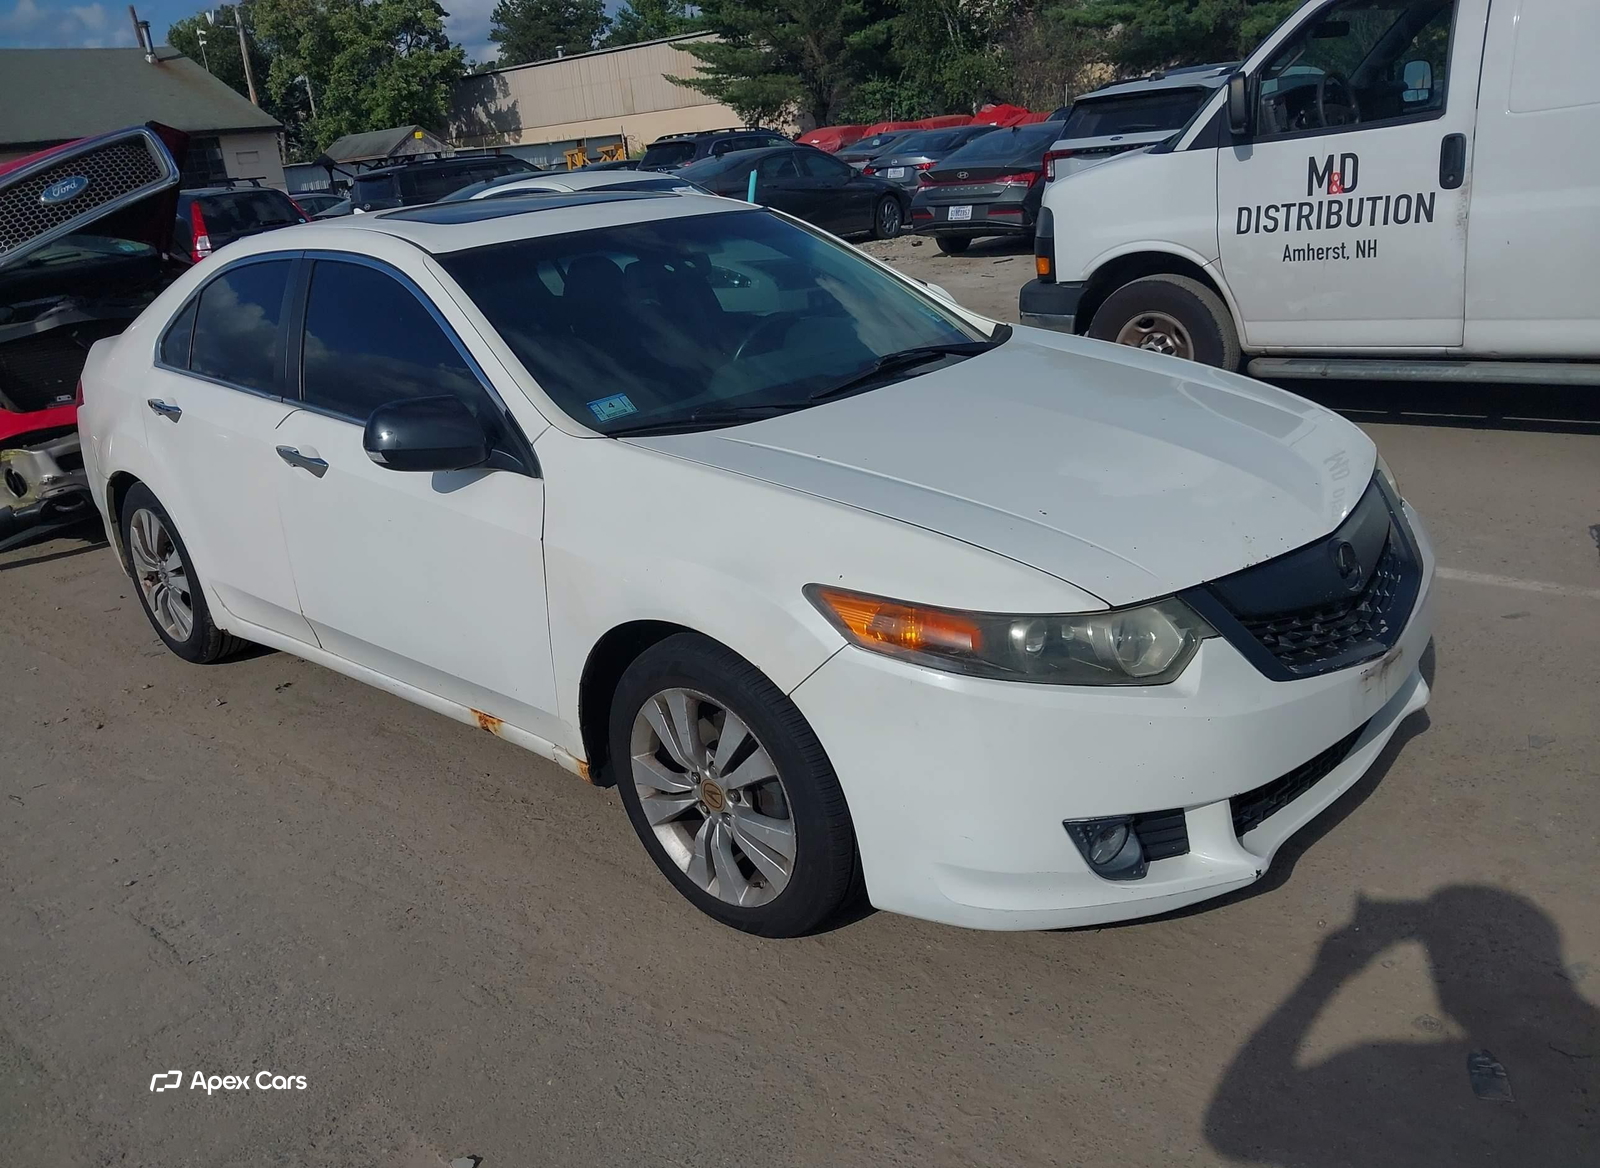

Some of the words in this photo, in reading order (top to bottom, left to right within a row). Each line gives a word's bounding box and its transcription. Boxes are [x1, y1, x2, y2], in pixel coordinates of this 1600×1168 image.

[52, 180, 78, 197] Ford
[1307, 153, 1359, 197] M&D
[1236, 192, 1436, 235] DISTRIBUTION
[1282, 242, 1350, 262] Amherst,
[1356, 239, 1378, 259] NH
